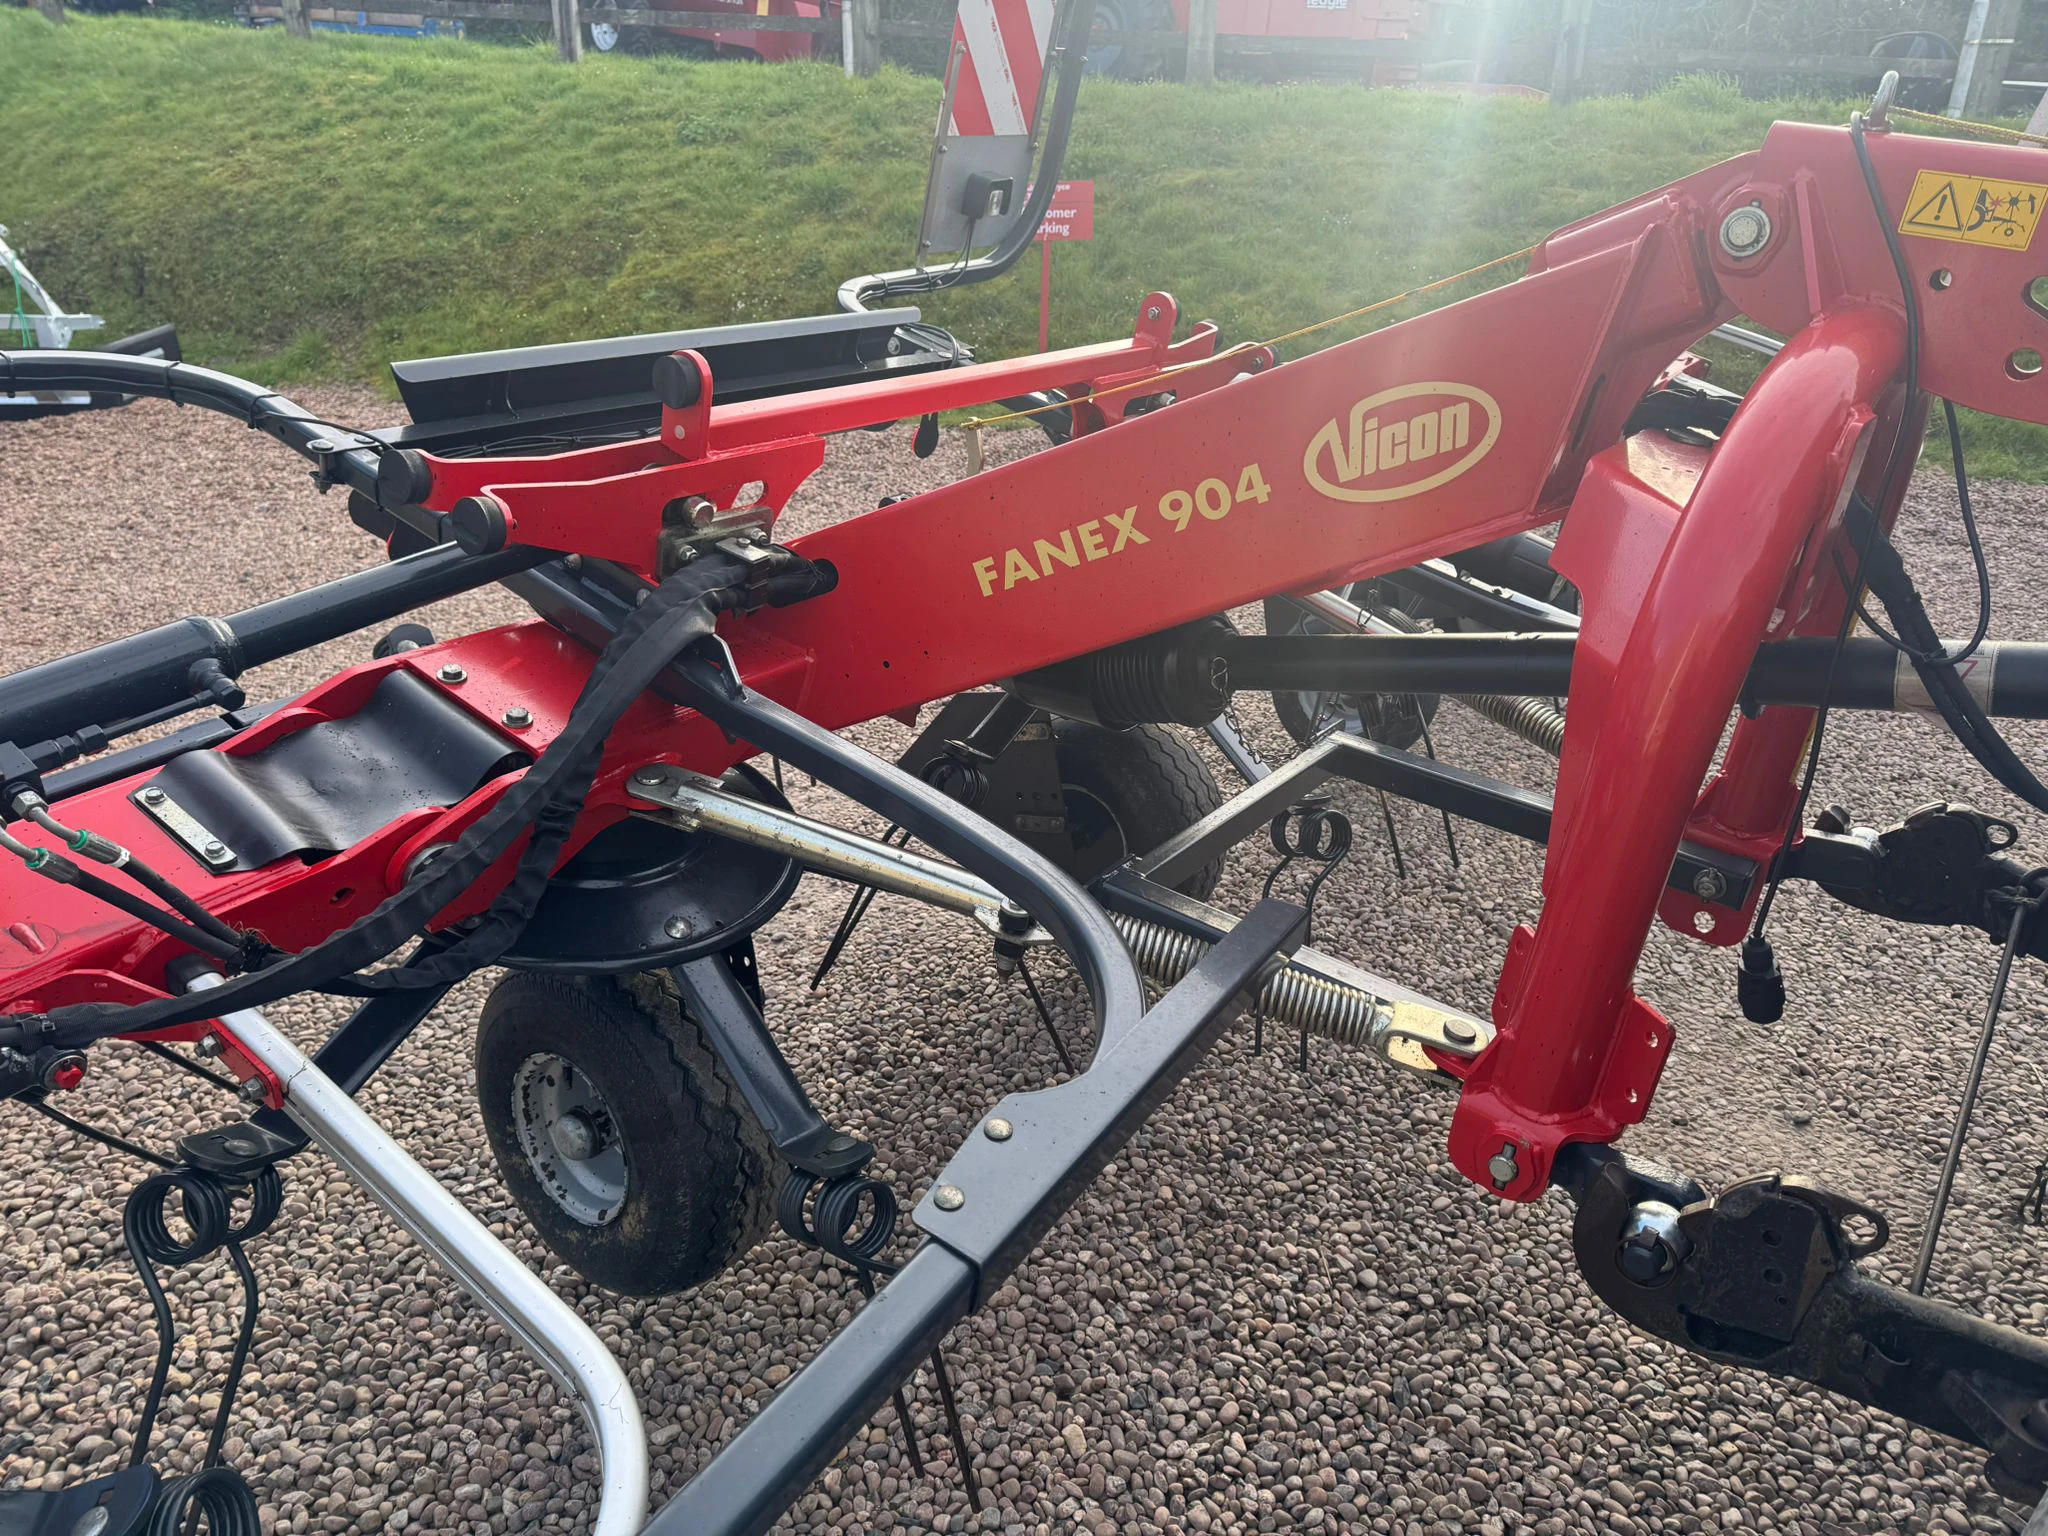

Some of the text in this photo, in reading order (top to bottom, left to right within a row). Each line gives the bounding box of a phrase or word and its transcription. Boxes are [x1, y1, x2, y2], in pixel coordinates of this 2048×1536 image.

[1037, 222, 1070, 236] rking
[1045, 209, 1077, 218] omer
[1328, 398, 1472, 485] Vicon
[972, 463, 1272, 597] FANEX 904
